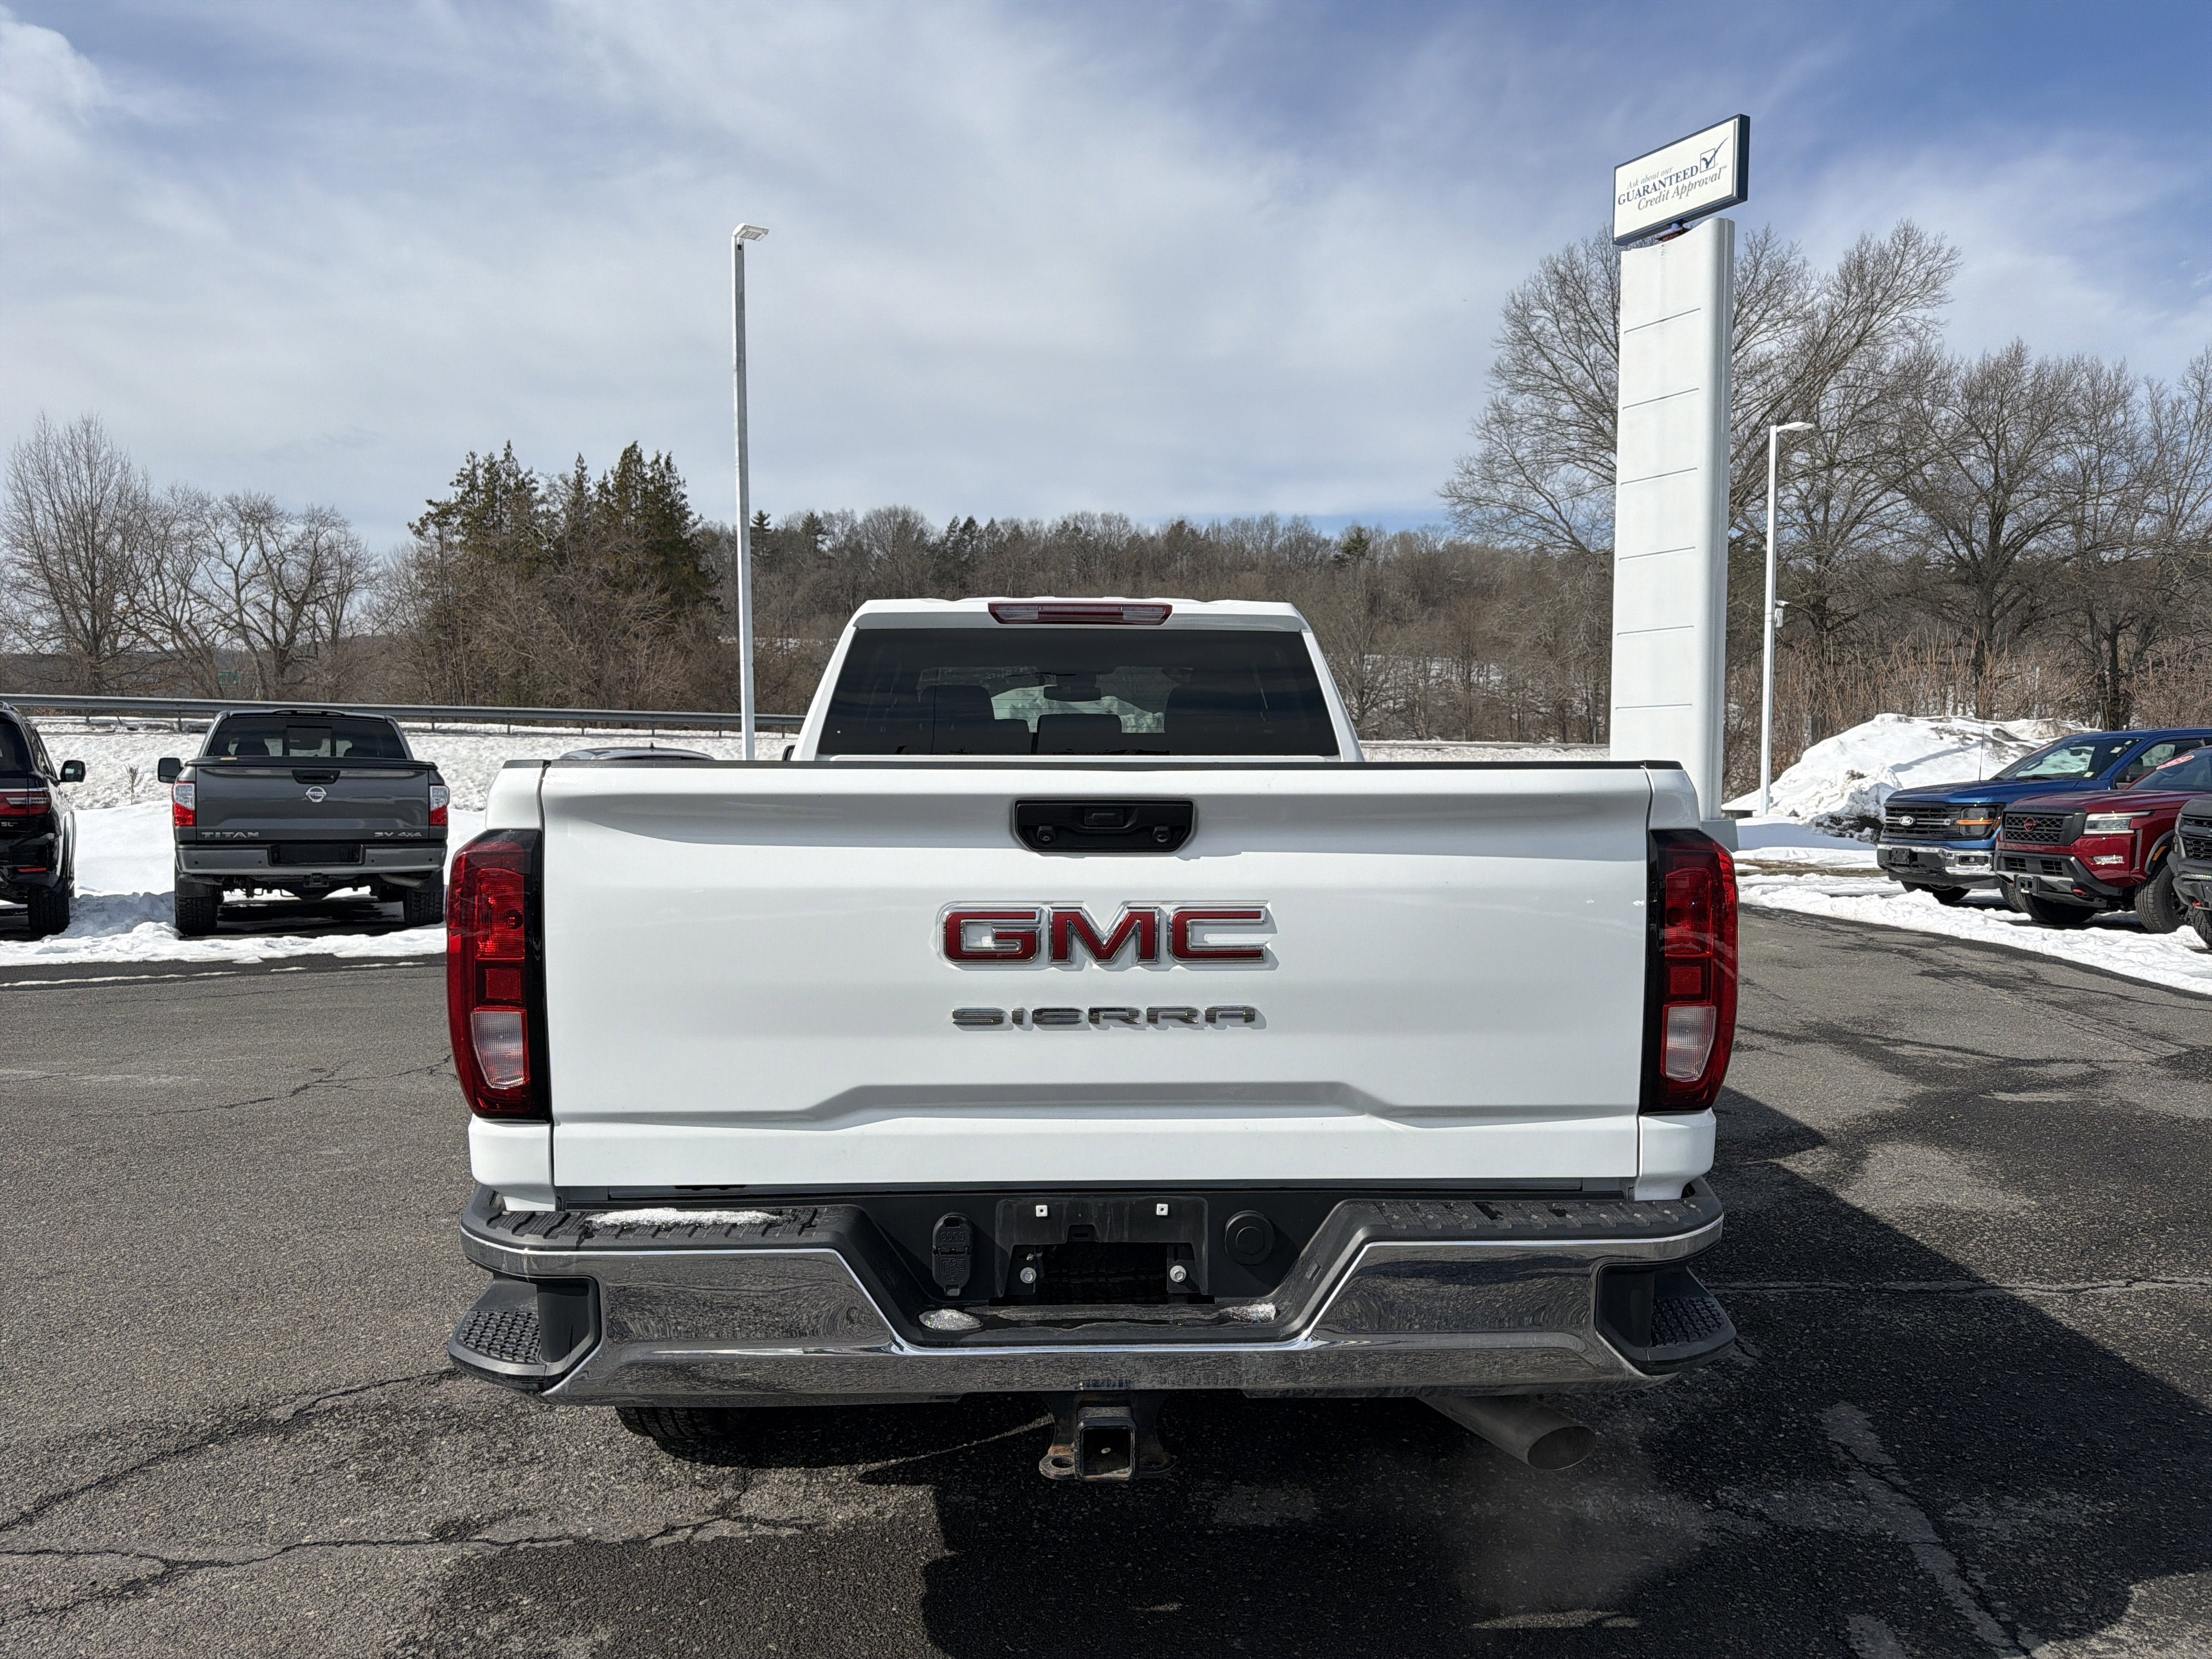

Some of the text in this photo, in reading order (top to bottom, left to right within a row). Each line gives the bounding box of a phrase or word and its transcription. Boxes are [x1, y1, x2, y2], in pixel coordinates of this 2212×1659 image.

[1618, 165, 1699, 206] GUARANTEED
[1627, 166, 1673, 190] Ask about our
[1638, 167, 1722, 211] Credit Approval
[943, 905, 1266, 964] GMC
[952, 1006, 1255, 1025] SIERRA
